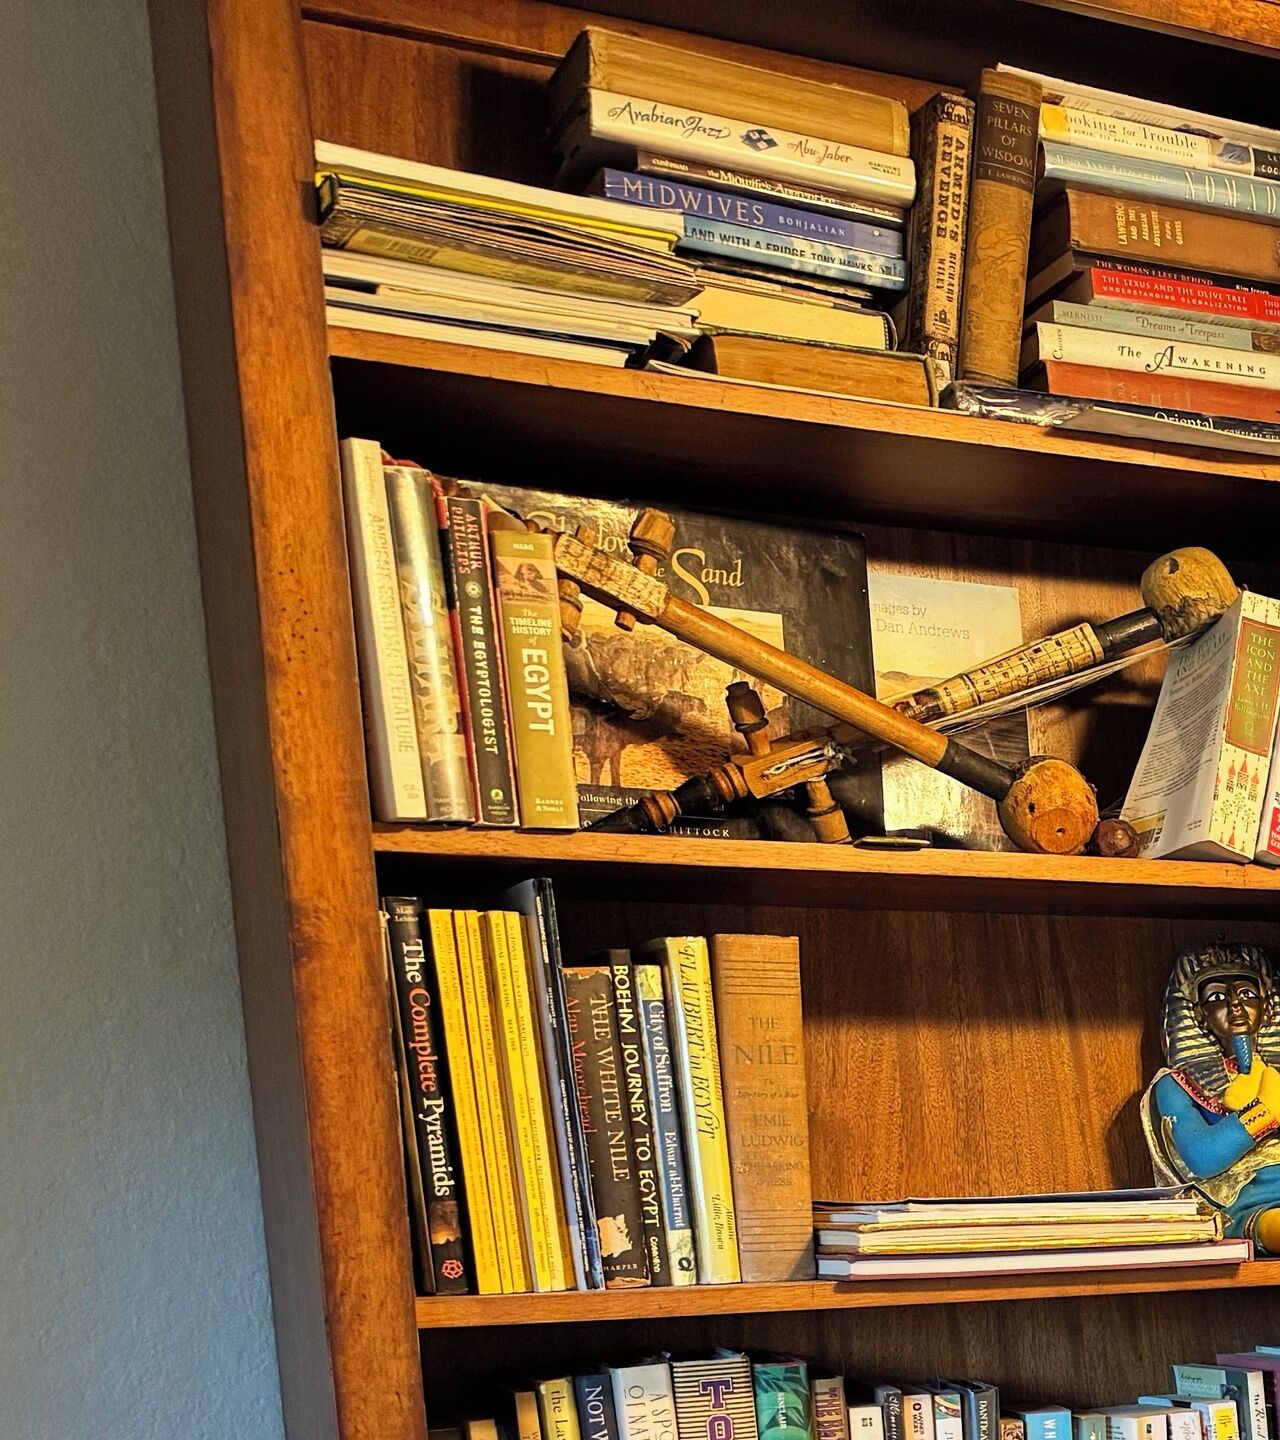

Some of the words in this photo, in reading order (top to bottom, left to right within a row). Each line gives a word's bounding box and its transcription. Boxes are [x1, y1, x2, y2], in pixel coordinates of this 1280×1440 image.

[608, 102, 685, 129] Arabian
[682, 116, 730, 138] Jazz
[987, 117, 1033, 137] PILLARS
[992, 101, 1030, 120] SEVEN
[1001, 135, 1018, 147] OF
[1066, 114, 1116, 137] ooking
[1122, 125, 1137, 138] for
[1138, 126, 1199, 152] Trouble
[982, 146, 1034, 171] WISDOM
[936, 134, 954, 239] REVENGE
[948, 137, 966, 243] AHMED'S
[623, 177, 765, 225] MIDWIVES
[778, 215, 846, 236] BOHJALIAN
[720, 233, 751, 249] WITH
[755, 241, 763, 251] A
[1102, 275, 1121, 285] THE
[1123, 278, 1151, 289] LEXUS
[1154, 281, 1174, 292] AND
[1177, 285, 1193, 295] THE
[1197, 287, 1223, 300] OLIVE
[1226, 292, 1247, 304] TREE
[1118, 345, 1142, 359] The
[451, 506, 471, 574] PHILLIPS
[465, 514, 483, 570] ARTHUR
[671, 547, 746, 606] Sand
[469, 606, 485, 636] THE
[510, 617, 553, 628] TIMELINE
[512, 626, 552, 636] HISTORY
[875, 617, 907, 637] Dan
[909, 619, 971, 641] Andrews
[1251, 632, 1275, 646] THE
[1246, 645, 1276, 661] ICON
[1246, 658, 1273, 673] AND
[521, 648, 555, 735] EGYPT
[1243, 682, 1267, 697] AXE
[1246, 670, 1269, 684] THE
[473, 640, 498, 754] EGYPTOLOGIST
[403, 939, 425, 983] The
[590, 994, 613, 1040] THE
[613, 965, 636, 1033] BOEHM
[679, 944, 705, 1056] FLAUBERT
[409, 987, 438, 1092] Complete
[732, 1043, 798, 1065] NILE
[690, 1055, 702, 1070] in
[596, 1047, 623, 1123] WHITE
[621, 1042, 648, 1126] JOURNEY
[694, 1074, 720, 1140] EGYPT
[417, 1095, 456, 1198] Pyramids
[607, 1131, 630, 1182] NILE
[635, 1133, 651, 1161] TO
[638, 1170, 660, 1228] EGYPT
[551, 1390, 566, 1414] the
[585, 1386, 605, 1425] NOT
